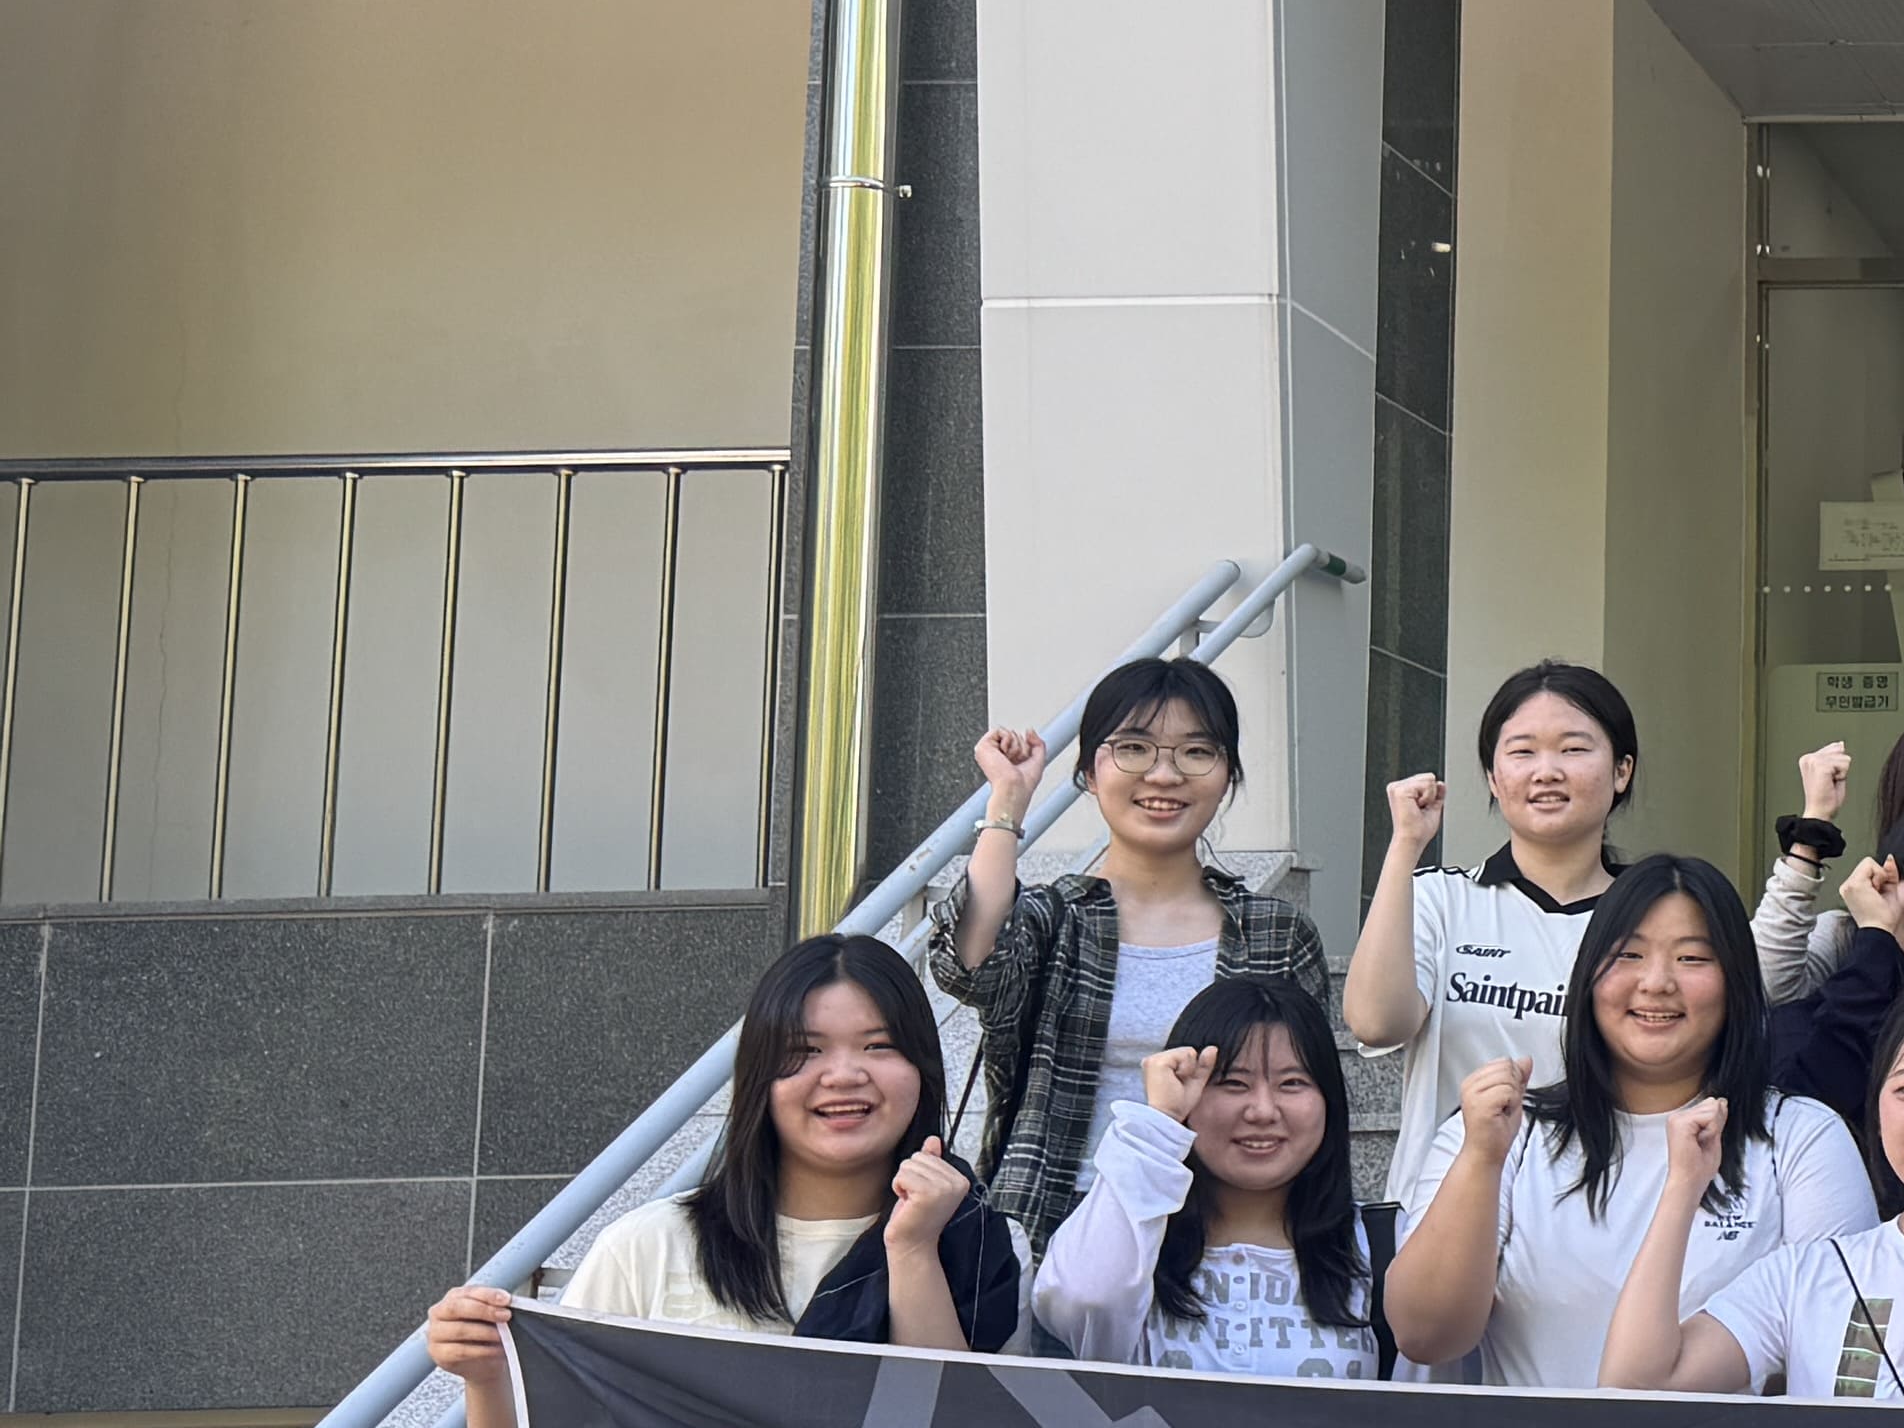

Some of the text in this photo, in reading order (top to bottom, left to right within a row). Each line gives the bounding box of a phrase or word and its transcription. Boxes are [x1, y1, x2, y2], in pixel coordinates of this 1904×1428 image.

[1827, 676, 1888, 689] 학생 증명
[1826, 695, 1889, 709] 무인발급기
[1456, 944, 1511, 958] SAINT
